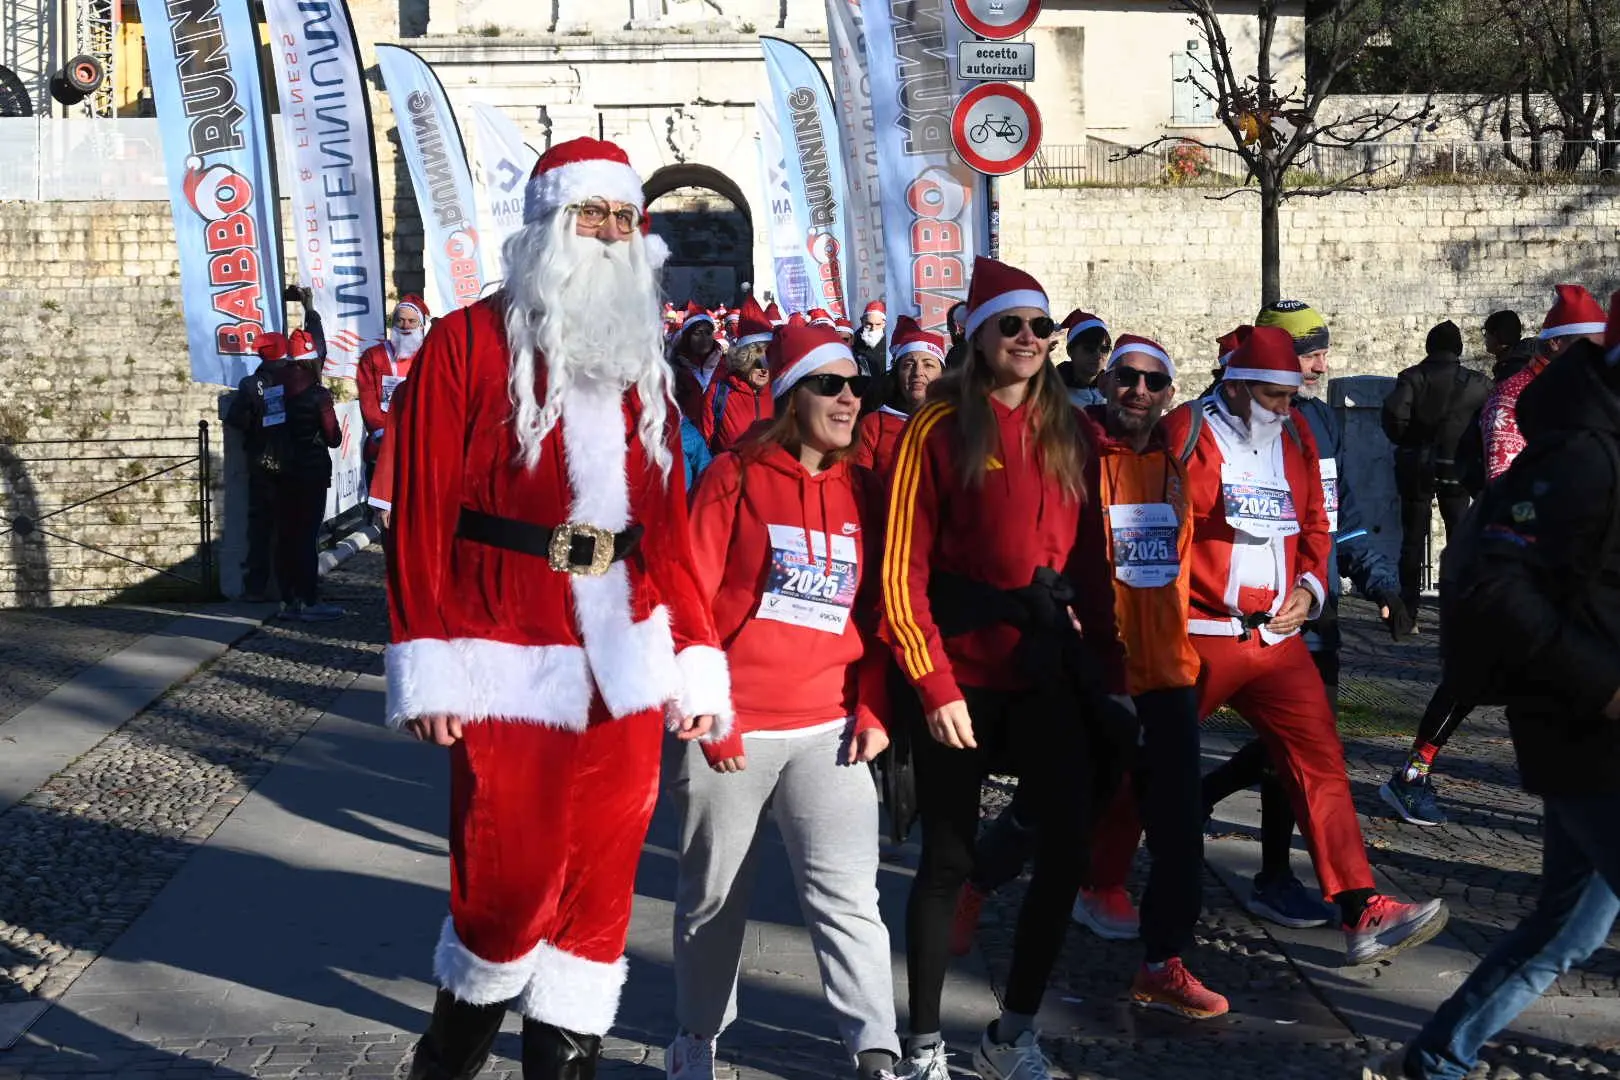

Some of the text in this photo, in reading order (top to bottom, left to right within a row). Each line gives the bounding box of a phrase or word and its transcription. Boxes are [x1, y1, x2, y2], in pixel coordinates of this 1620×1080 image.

[976, 48, 1018, 59] eccetto
[966, 63, 1027, 75] autorizzati
[787, 87, 837, 228] RUNNING
[200, 163, 265, 355] BABBO
[1239, 497, 1281, 517] 2025
[1128, 540, 1169, 561] 2025
[782, 567, 839, 599] 2025
